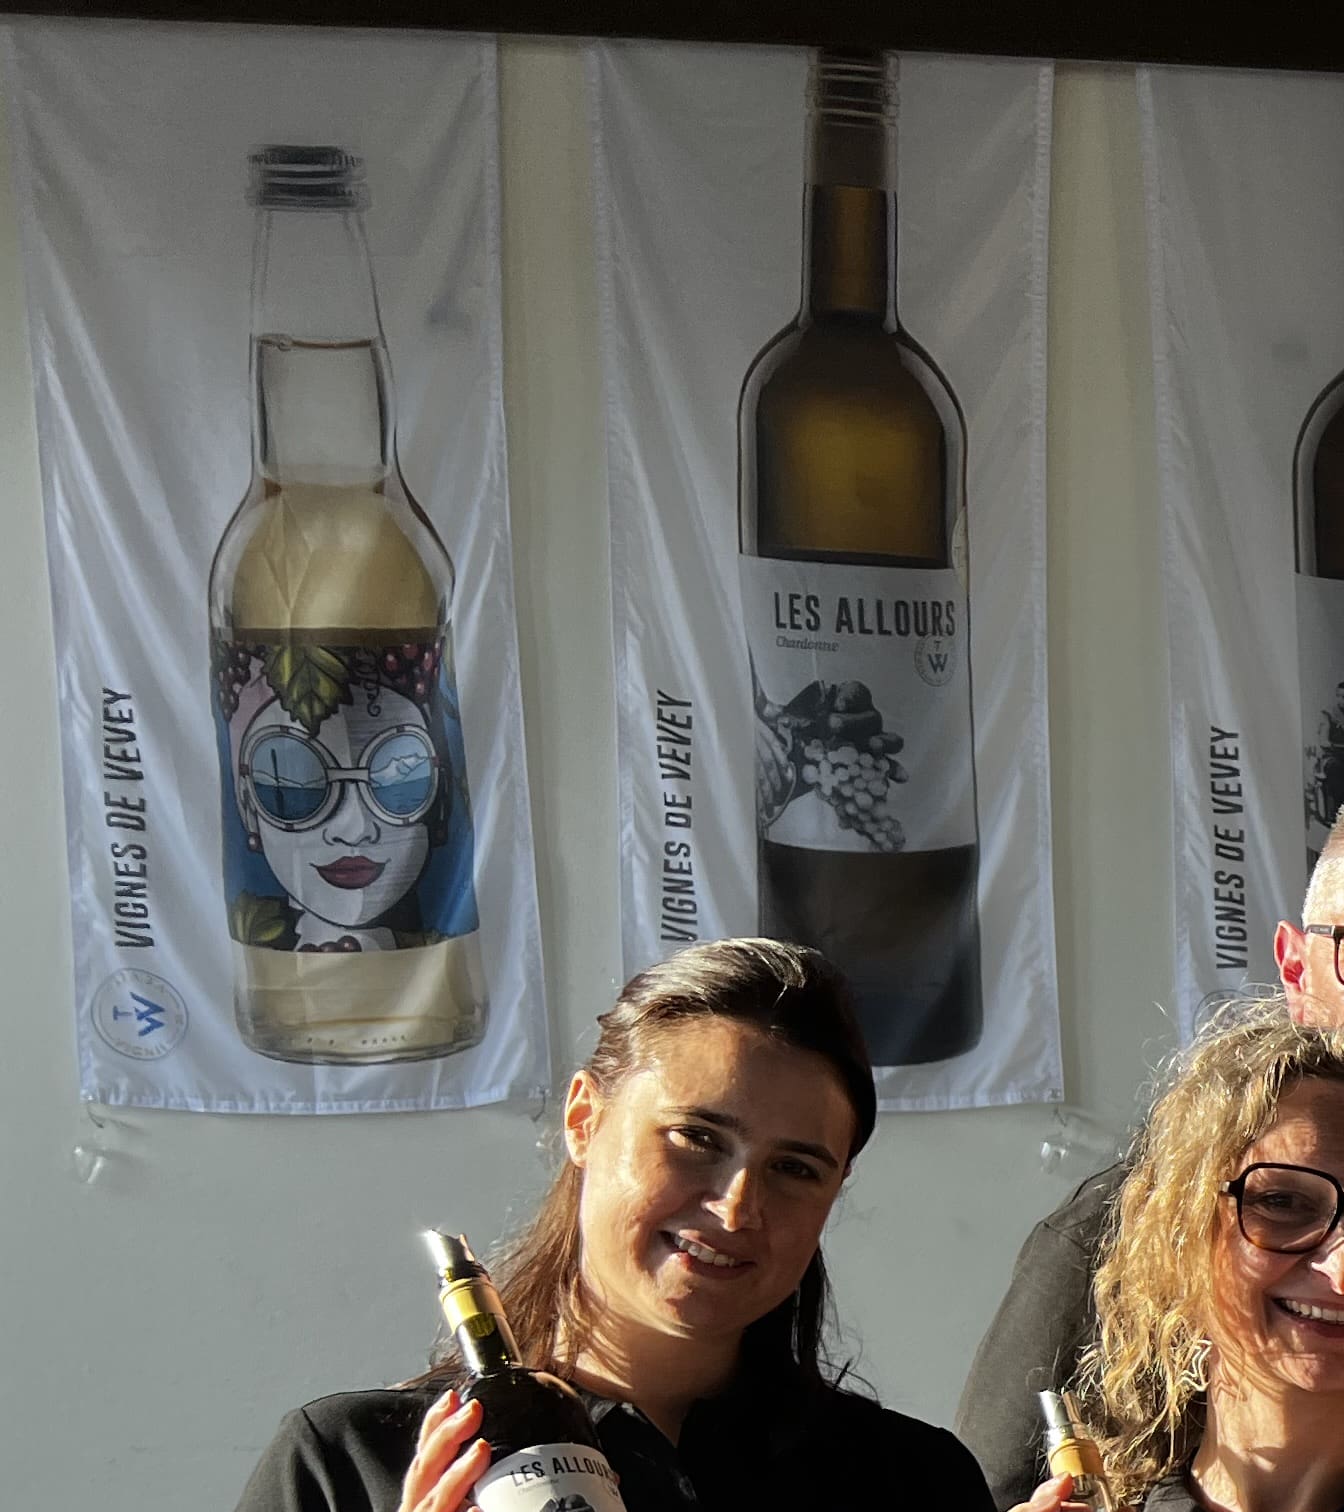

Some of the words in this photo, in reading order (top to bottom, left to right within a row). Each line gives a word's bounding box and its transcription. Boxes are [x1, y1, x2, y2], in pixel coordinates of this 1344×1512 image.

[774, 592, 821, 631] LES
[835, 597, 955, 637] ALLOURS
[102, 687, 145, 782] VEVEY
[656, 689, 693, 781] VEVEY
[1210, 726, 1243, 814] VEVEY
[104, 791, 147, 832] DE
[664, 791, 692, 828] DE
[1214, 824, 1245, 862] DE
[110, 840, 155, 948] VIGNES
[660, 840, 698, 942] VIGNES
[1214, 870, 1249, 969] VIGNES
[511, 1460, 545, 1488] LES
